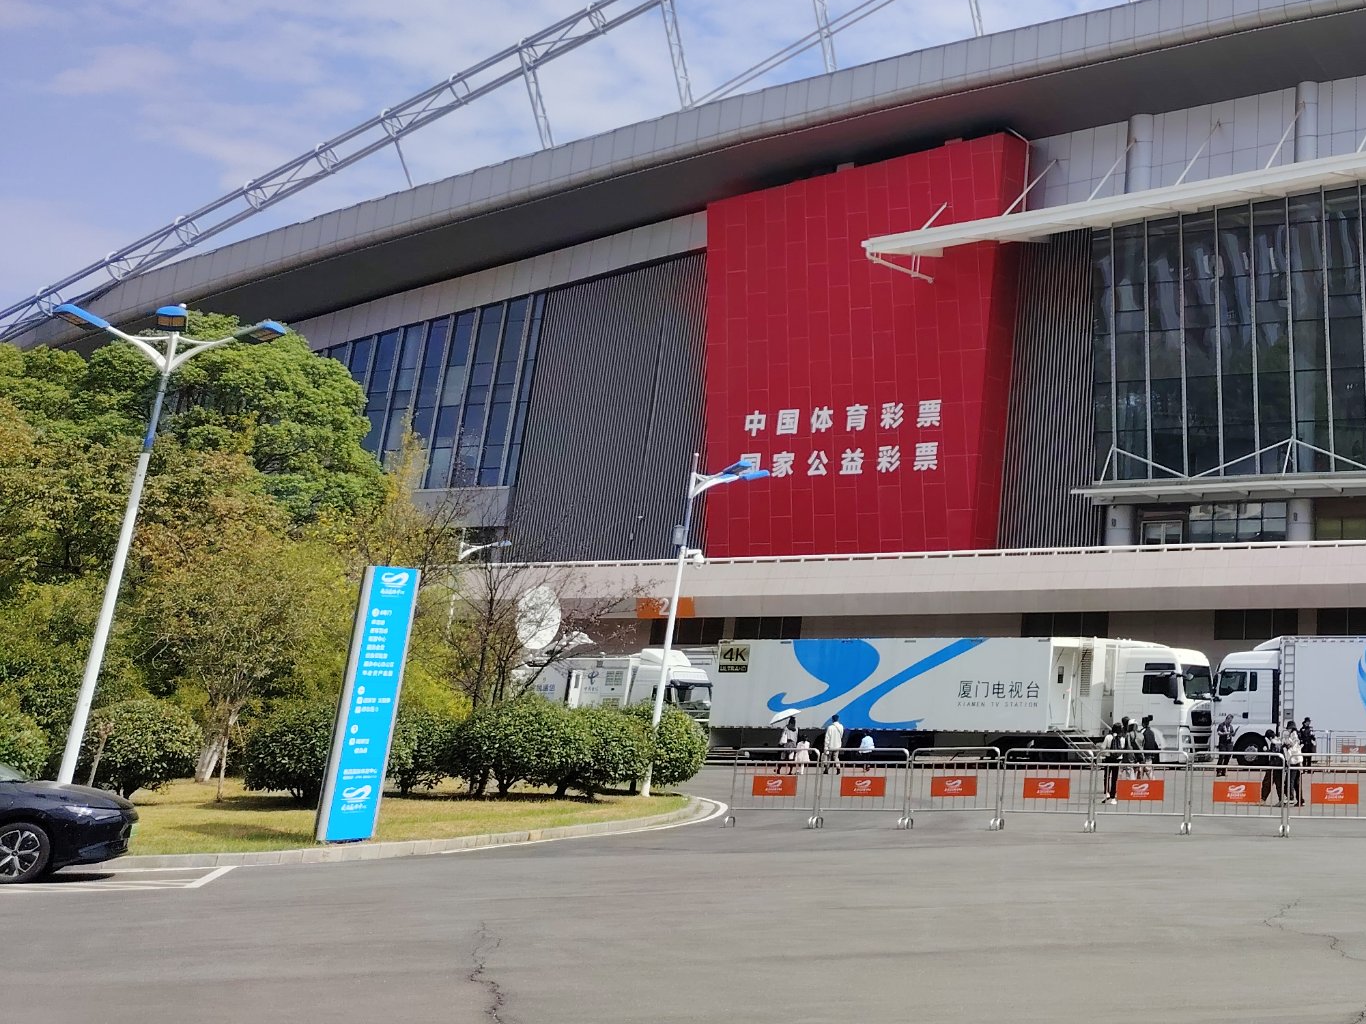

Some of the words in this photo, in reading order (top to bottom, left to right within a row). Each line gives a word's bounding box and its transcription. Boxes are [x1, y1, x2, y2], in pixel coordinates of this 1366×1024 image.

[744, 399, 942, 437] 中国体育彩票
[723, 647, 747, 662] 4K
[957, 680, 1040, 699] 厦门电视台
